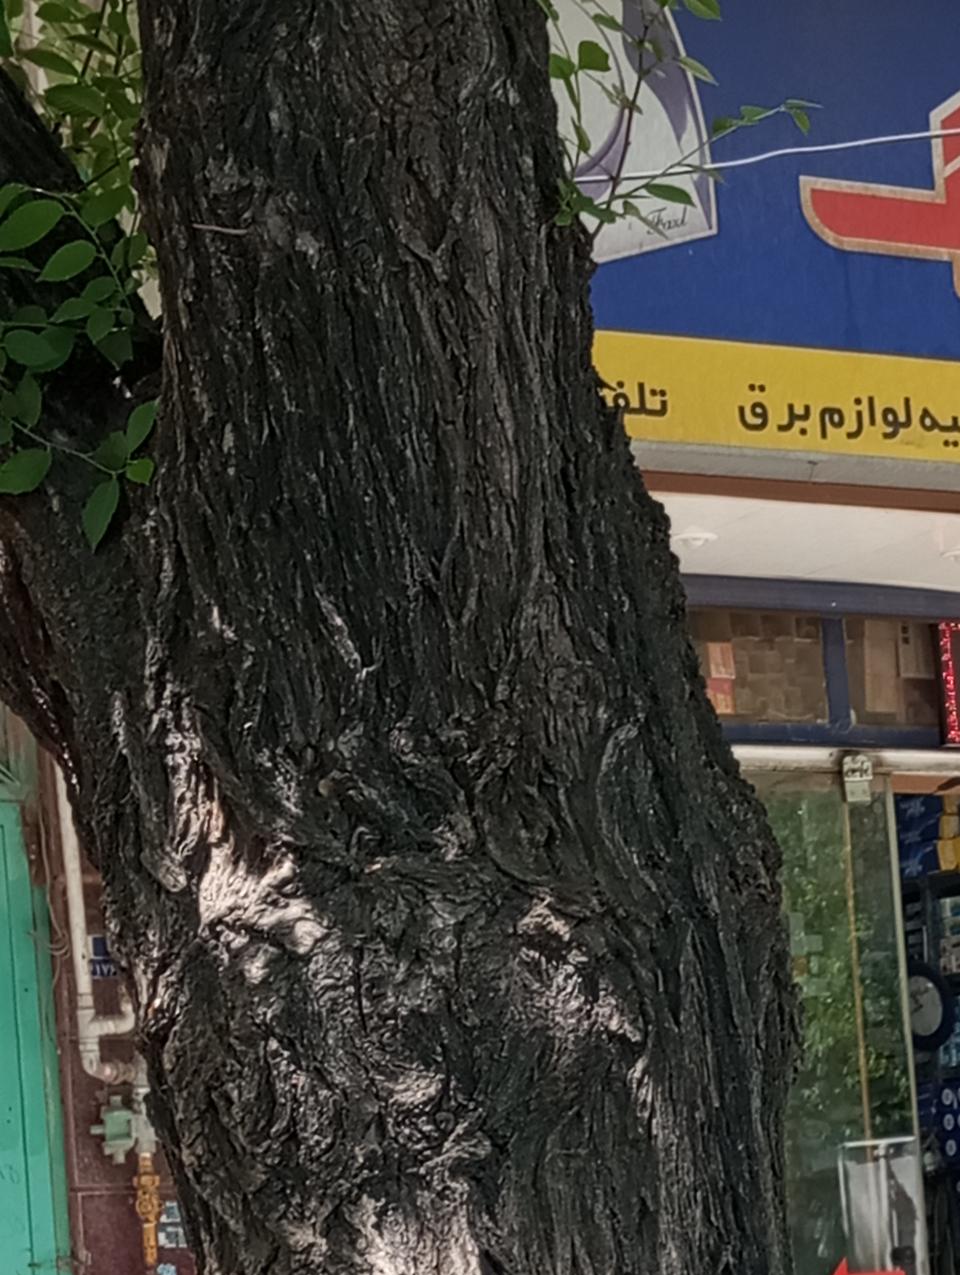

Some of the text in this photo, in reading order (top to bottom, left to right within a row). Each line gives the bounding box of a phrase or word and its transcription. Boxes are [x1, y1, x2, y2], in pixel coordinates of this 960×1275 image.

[598, 380, 668, 417] تلف
[737, 383, 811, 433] برق
[818, 396, 912, 440] لوازم
